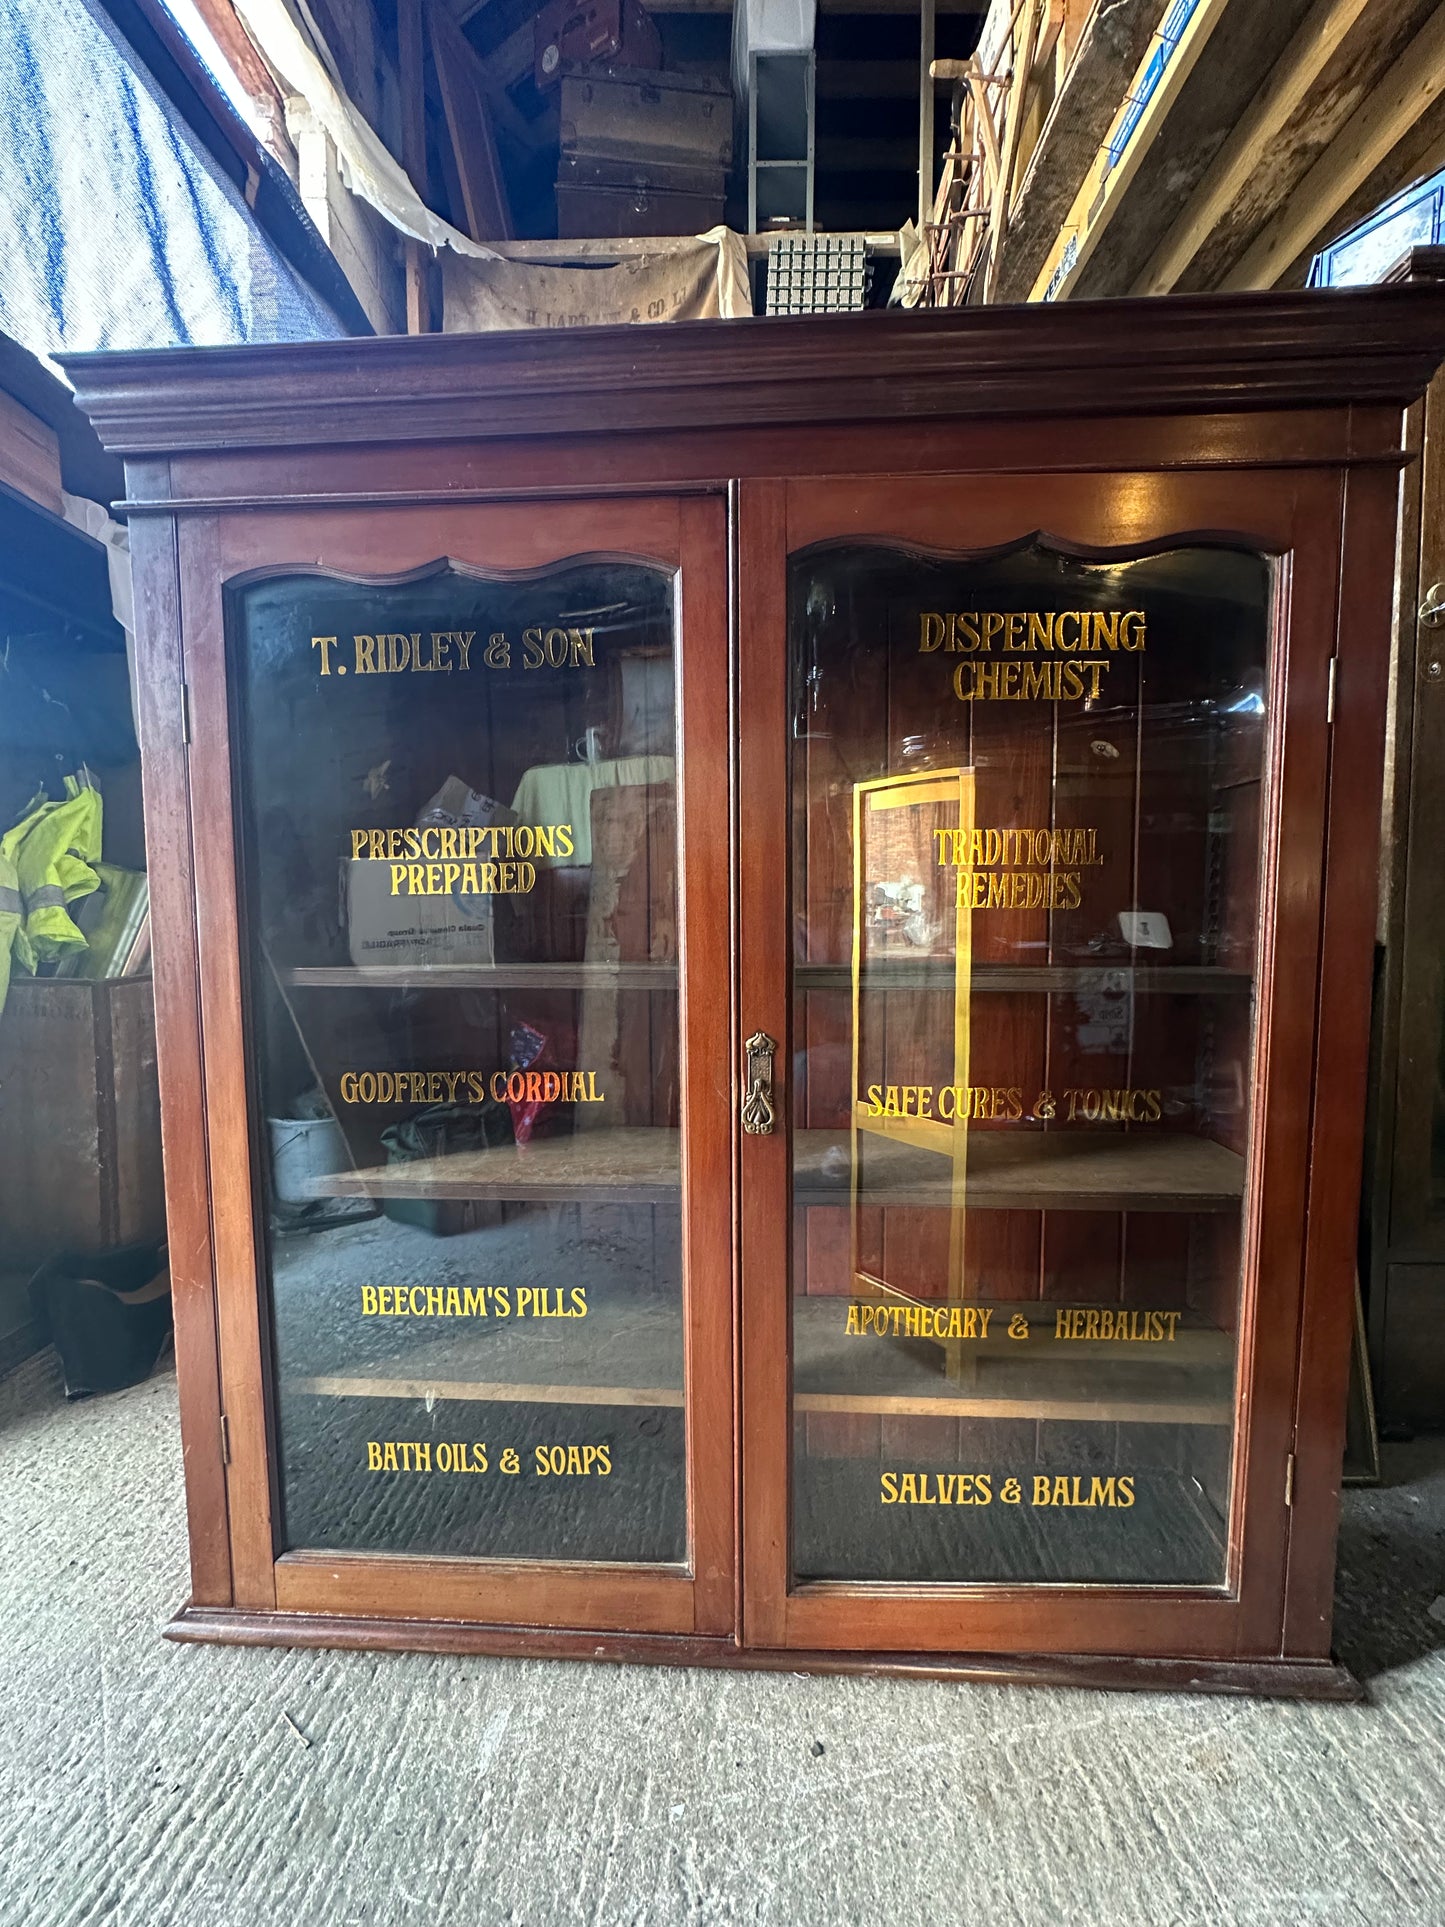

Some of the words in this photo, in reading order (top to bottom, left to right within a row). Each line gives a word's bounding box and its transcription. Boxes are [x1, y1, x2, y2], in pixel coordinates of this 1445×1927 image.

[918, 611, 1147, 652] DISPENCING
[311, 636, 347, 675] T.
[353, 631, 476, 674] RIDLEY
[484, 632, 511, 669] &
[522, 627, 597, 669] SON
[953, 660, 1110, 700] CHEMIST
[351, 824, 574, 861] PRESCRIPTIONS
[933, 828, 1104, 866] TRADITIONAL
[389, 861, 536, 896] PREPARED
[955, 871, 1081, 910] REMEDIES
[340, 1071, 485, 1103] GODFREY'S
[489, 1070, 605, 1103] CORDIAL
[867, 1084, 933, 1118] SAFE
[938, 1085, 1023, 1121] CURES
[1033, 1090, 1056, 1120] &
[1063, 1088, 1162, 1122] TONICS
[360, 1285, 511, 1318] BEECHAM'S
[515, 1287, 589, 1318] PILLS
[844, 1305, 993, 1339] APOTHECARY
[1007, 1312, 1029, 1340] &
[1054, 1308, 1181, 1342] HERBALIST
[367, 1441, 432, 1472] BATH
[436, 1442, 488, 1473] OILS
[499, 1447, 520, 1475] &
[535, 1445, 612, 1476] SOAPS
[880, 1472, 993, 1505] SALVES
[1000, 1477, 1022, 1505] &
[1031, 1475, 1135, 1507] BALMS
